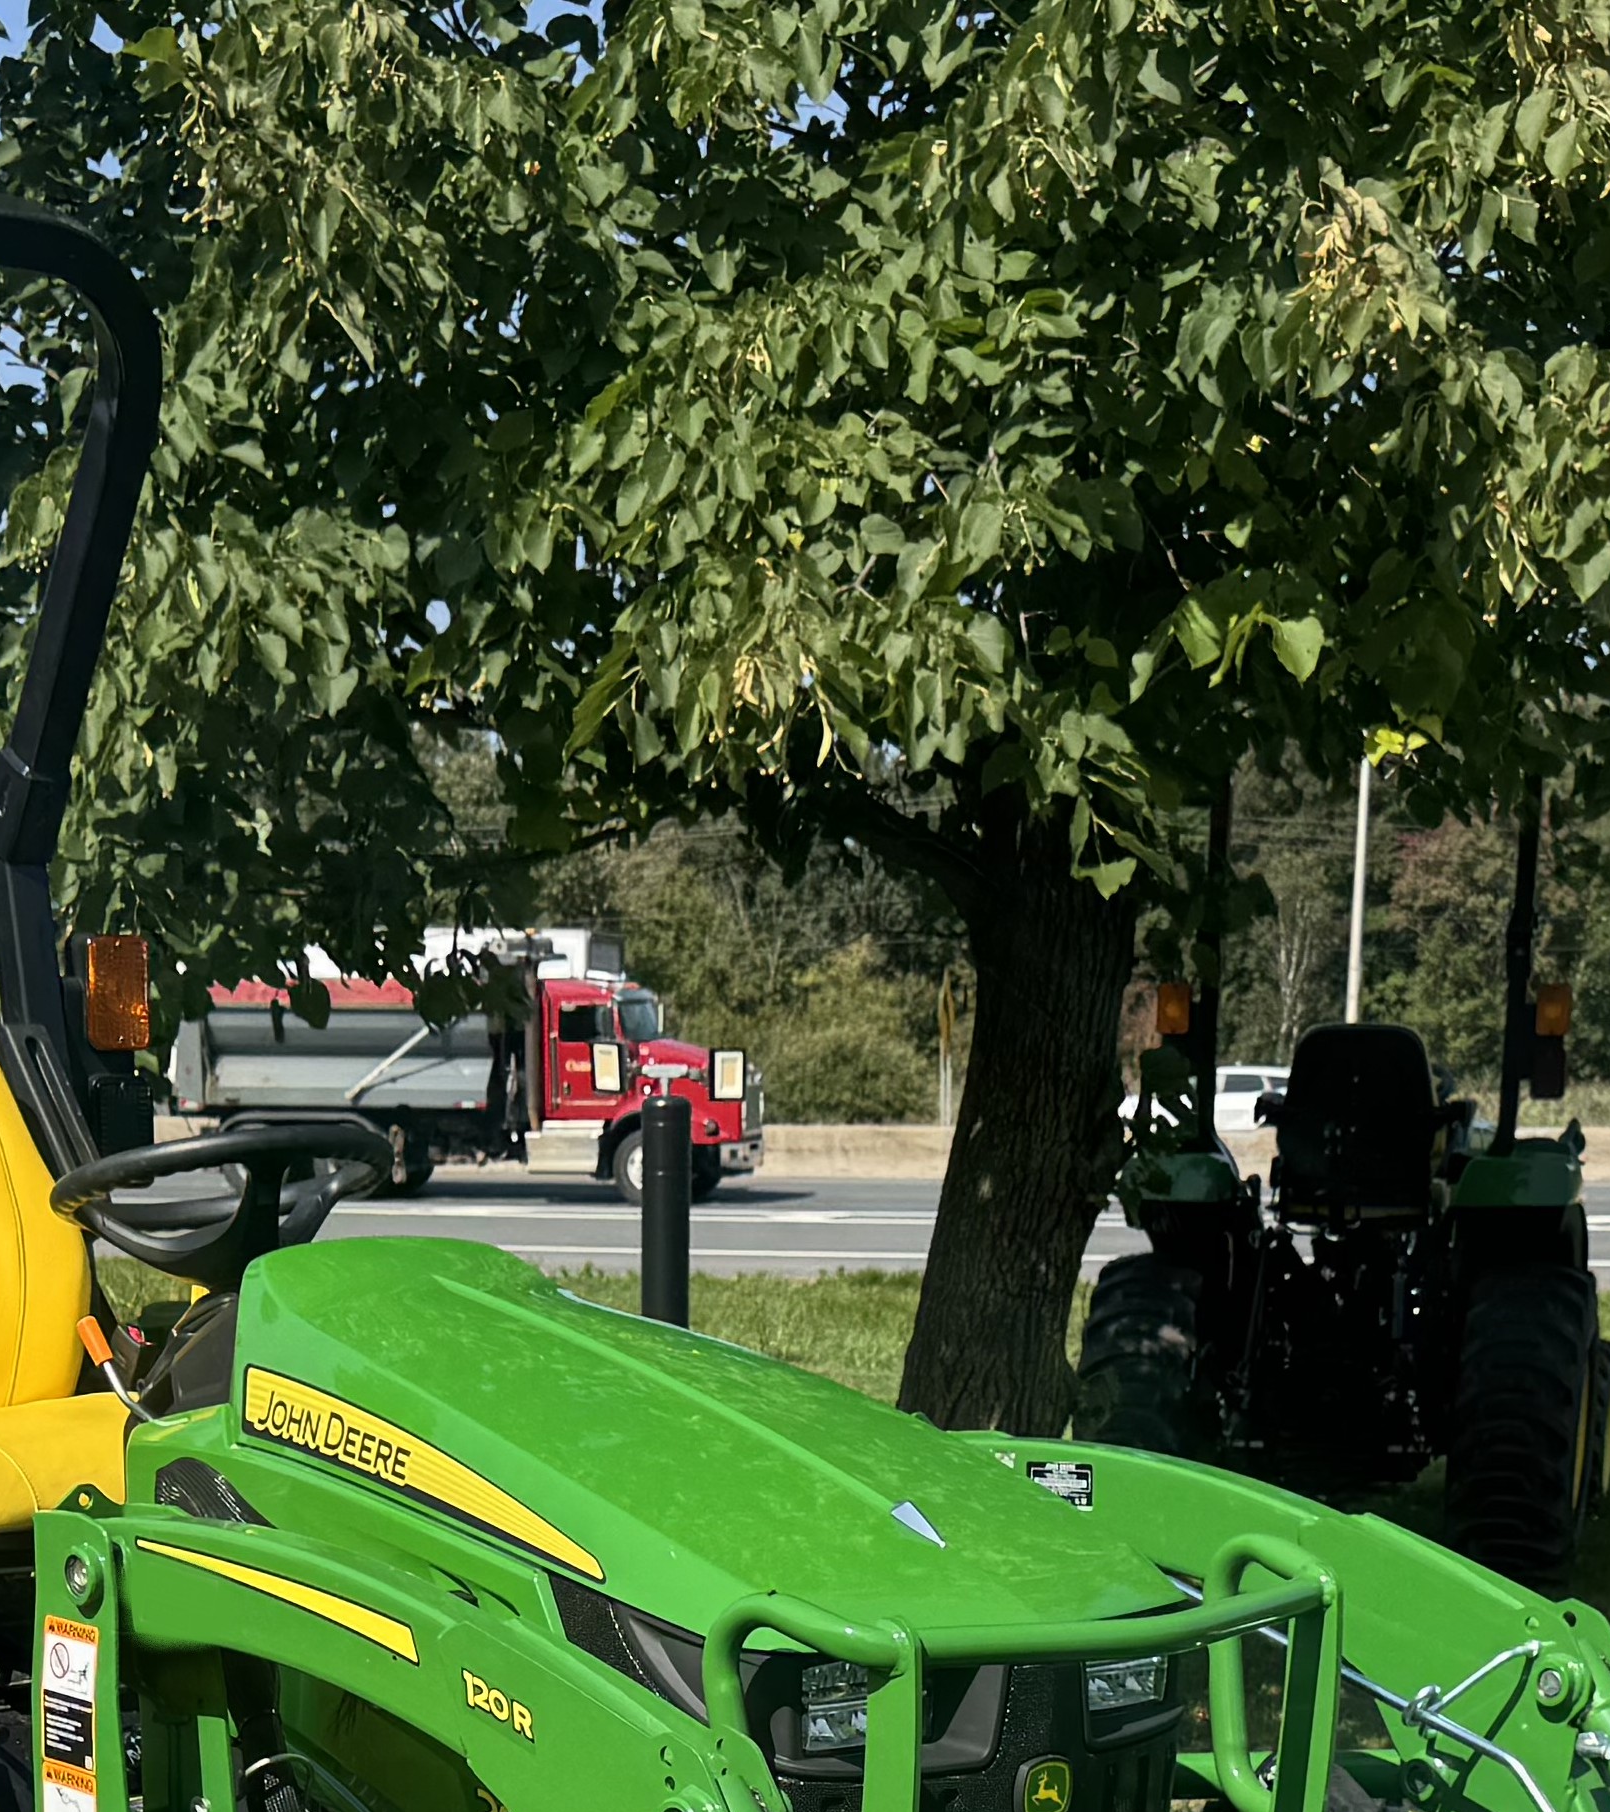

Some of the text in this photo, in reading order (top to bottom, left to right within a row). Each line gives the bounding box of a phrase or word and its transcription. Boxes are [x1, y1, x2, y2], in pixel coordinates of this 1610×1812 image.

[258, 1390, 411, 1481] JOHN DEERE
[53, 1768, 94, 1793] WARNING
